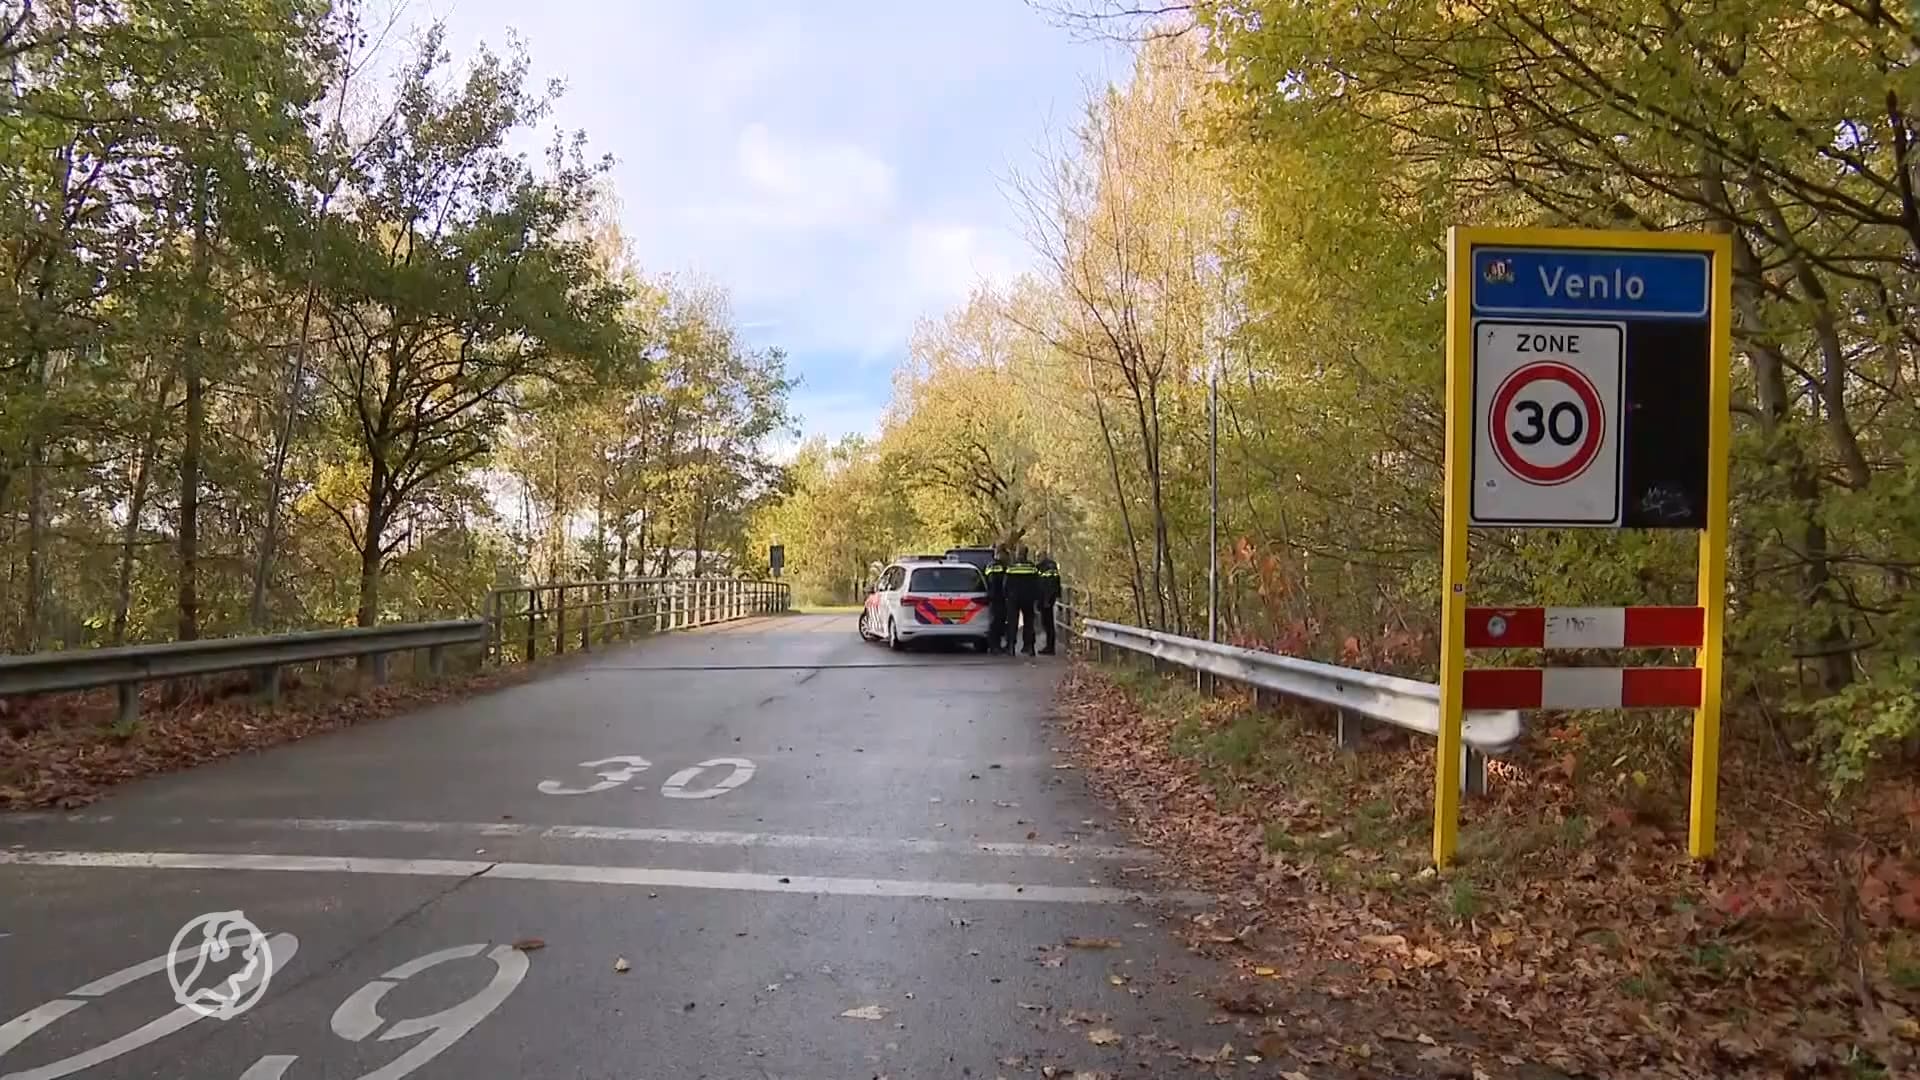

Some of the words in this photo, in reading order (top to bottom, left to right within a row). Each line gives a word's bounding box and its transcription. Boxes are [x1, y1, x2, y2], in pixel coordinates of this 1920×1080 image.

[1538, 264, 1646, 301] Venlo
[1516, 333, 1581, 354] ZONE
[1511, 399, 1584, 447] 30
[537, 754, 757, 800] 30
